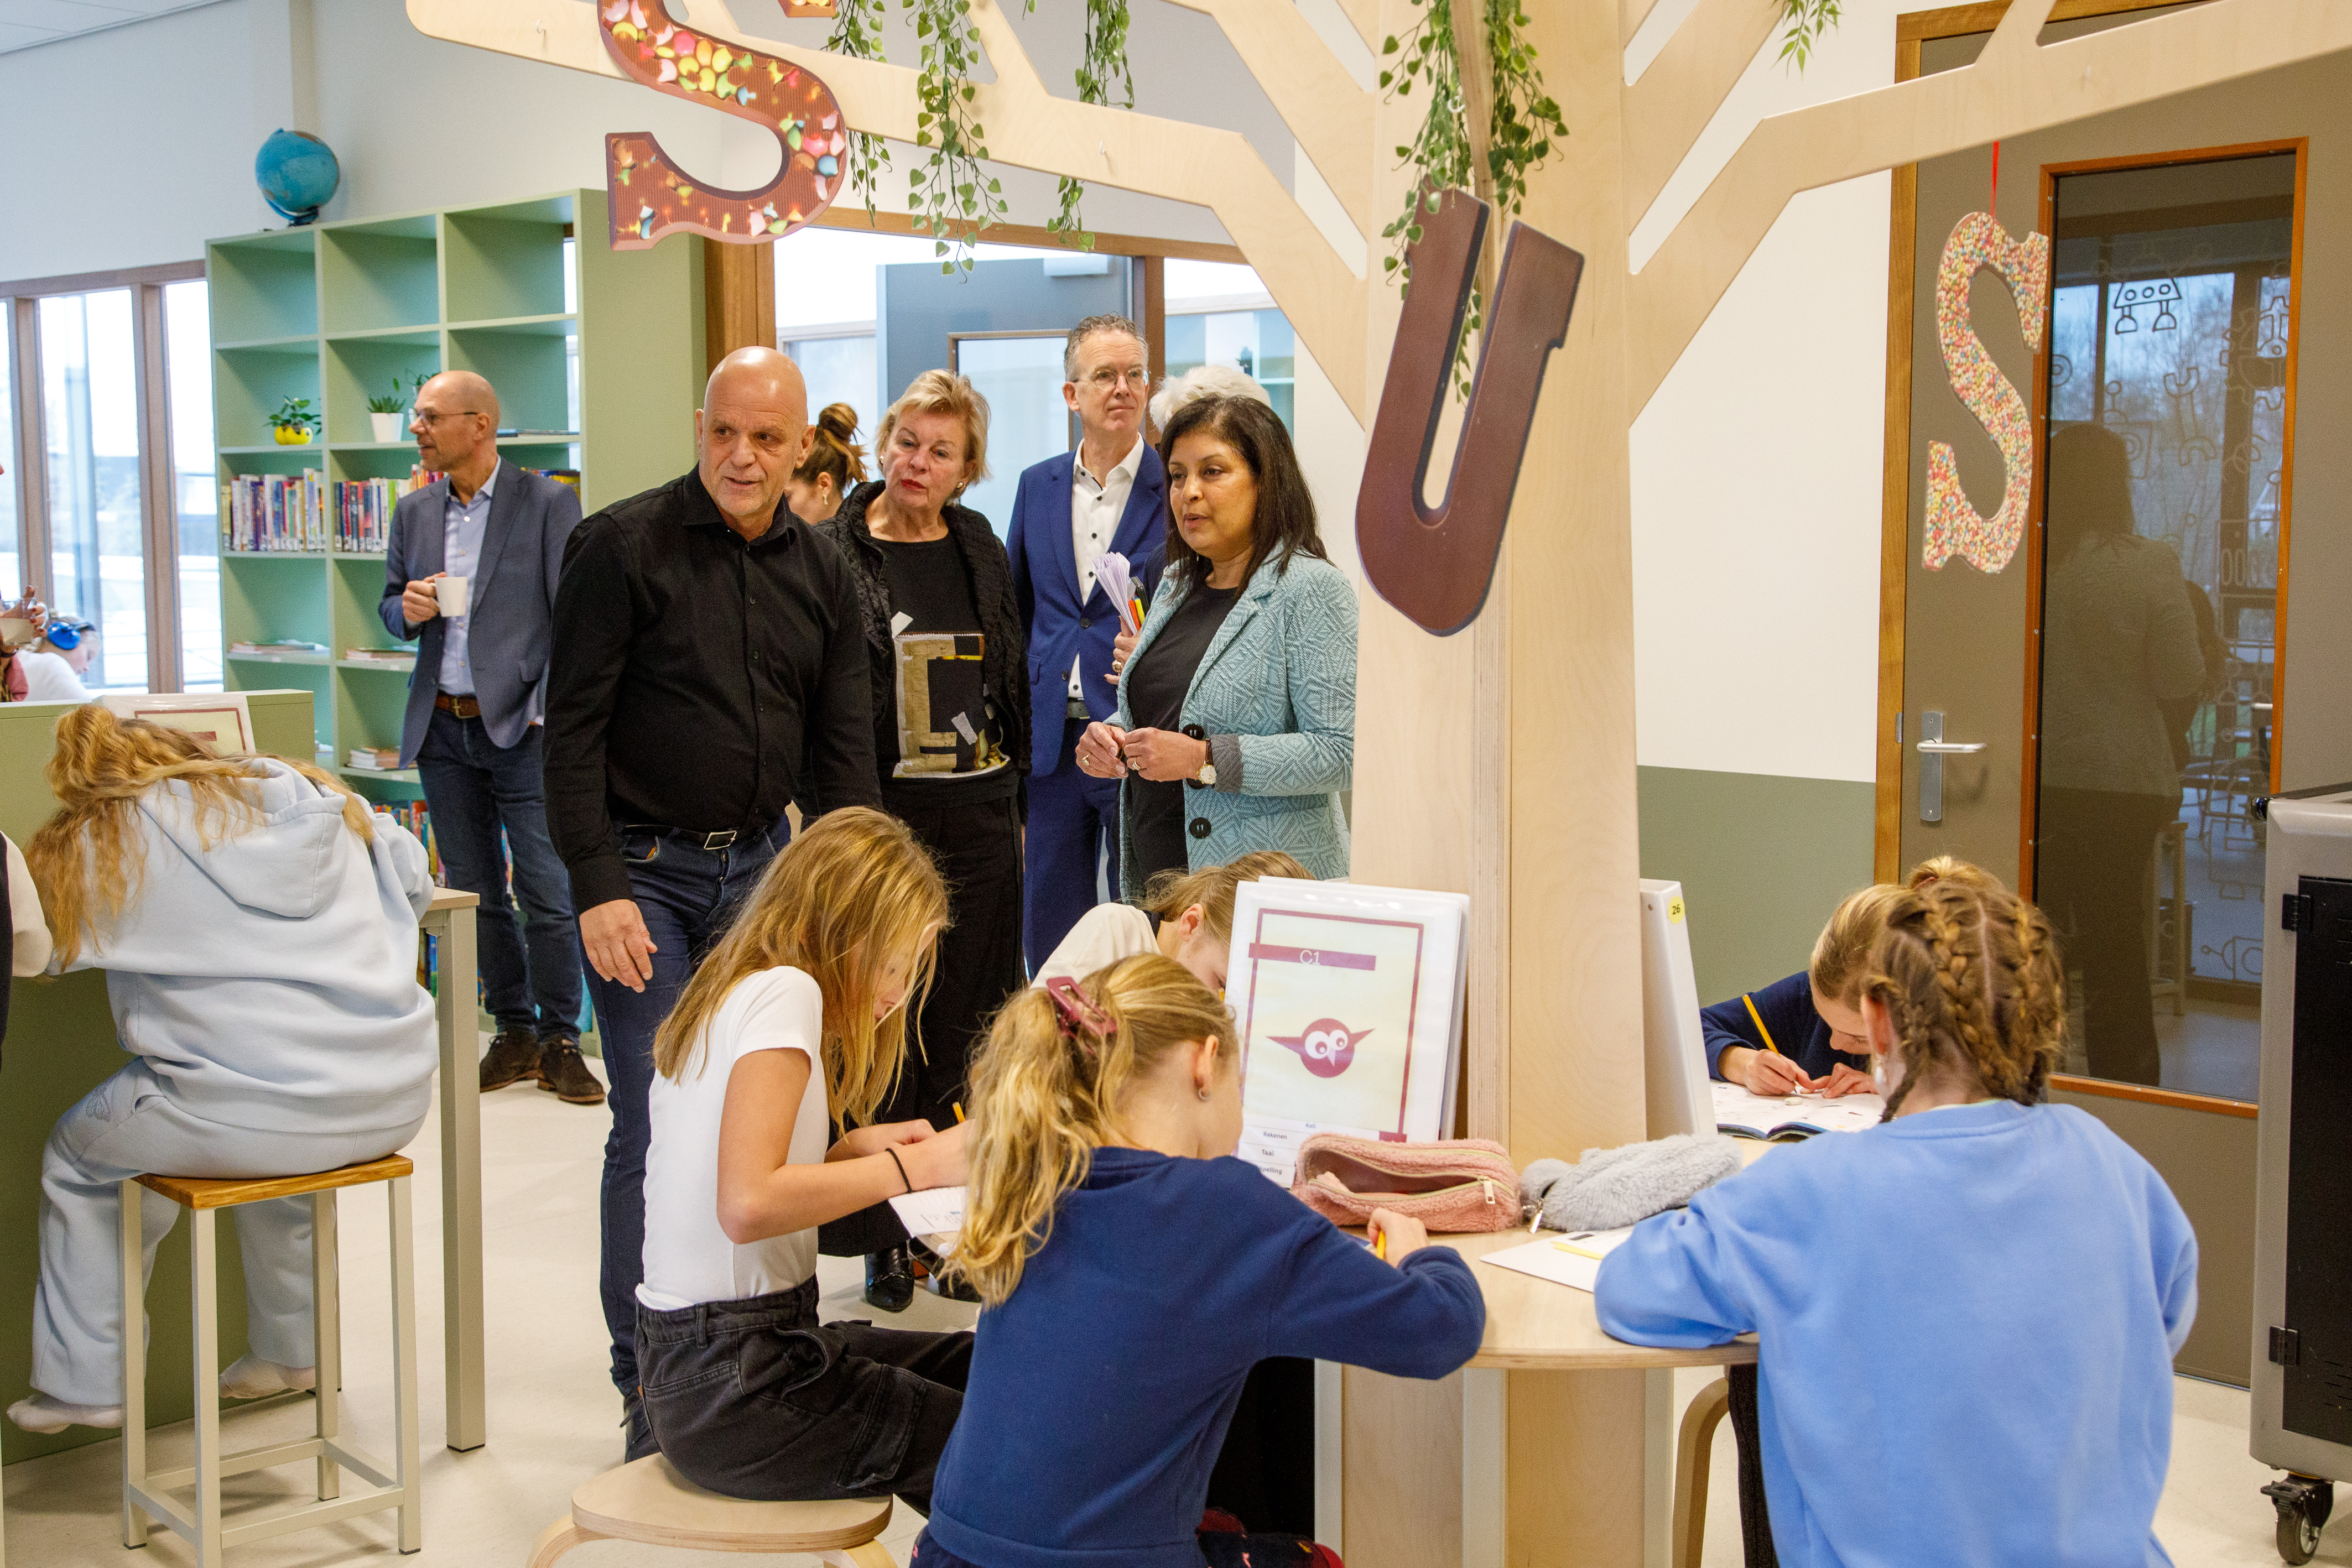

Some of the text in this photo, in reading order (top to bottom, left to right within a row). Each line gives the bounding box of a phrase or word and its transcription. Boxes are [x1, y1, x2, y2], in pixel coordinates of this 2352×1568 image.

[1923, 212, 2049, 574] S
[1355, 180, 1585, 637] U
[1672, 904, 1680, 915] 26
[1300, 950, 1320, 965] C1
[1259, 1166, 1282, 1175] Spelling
